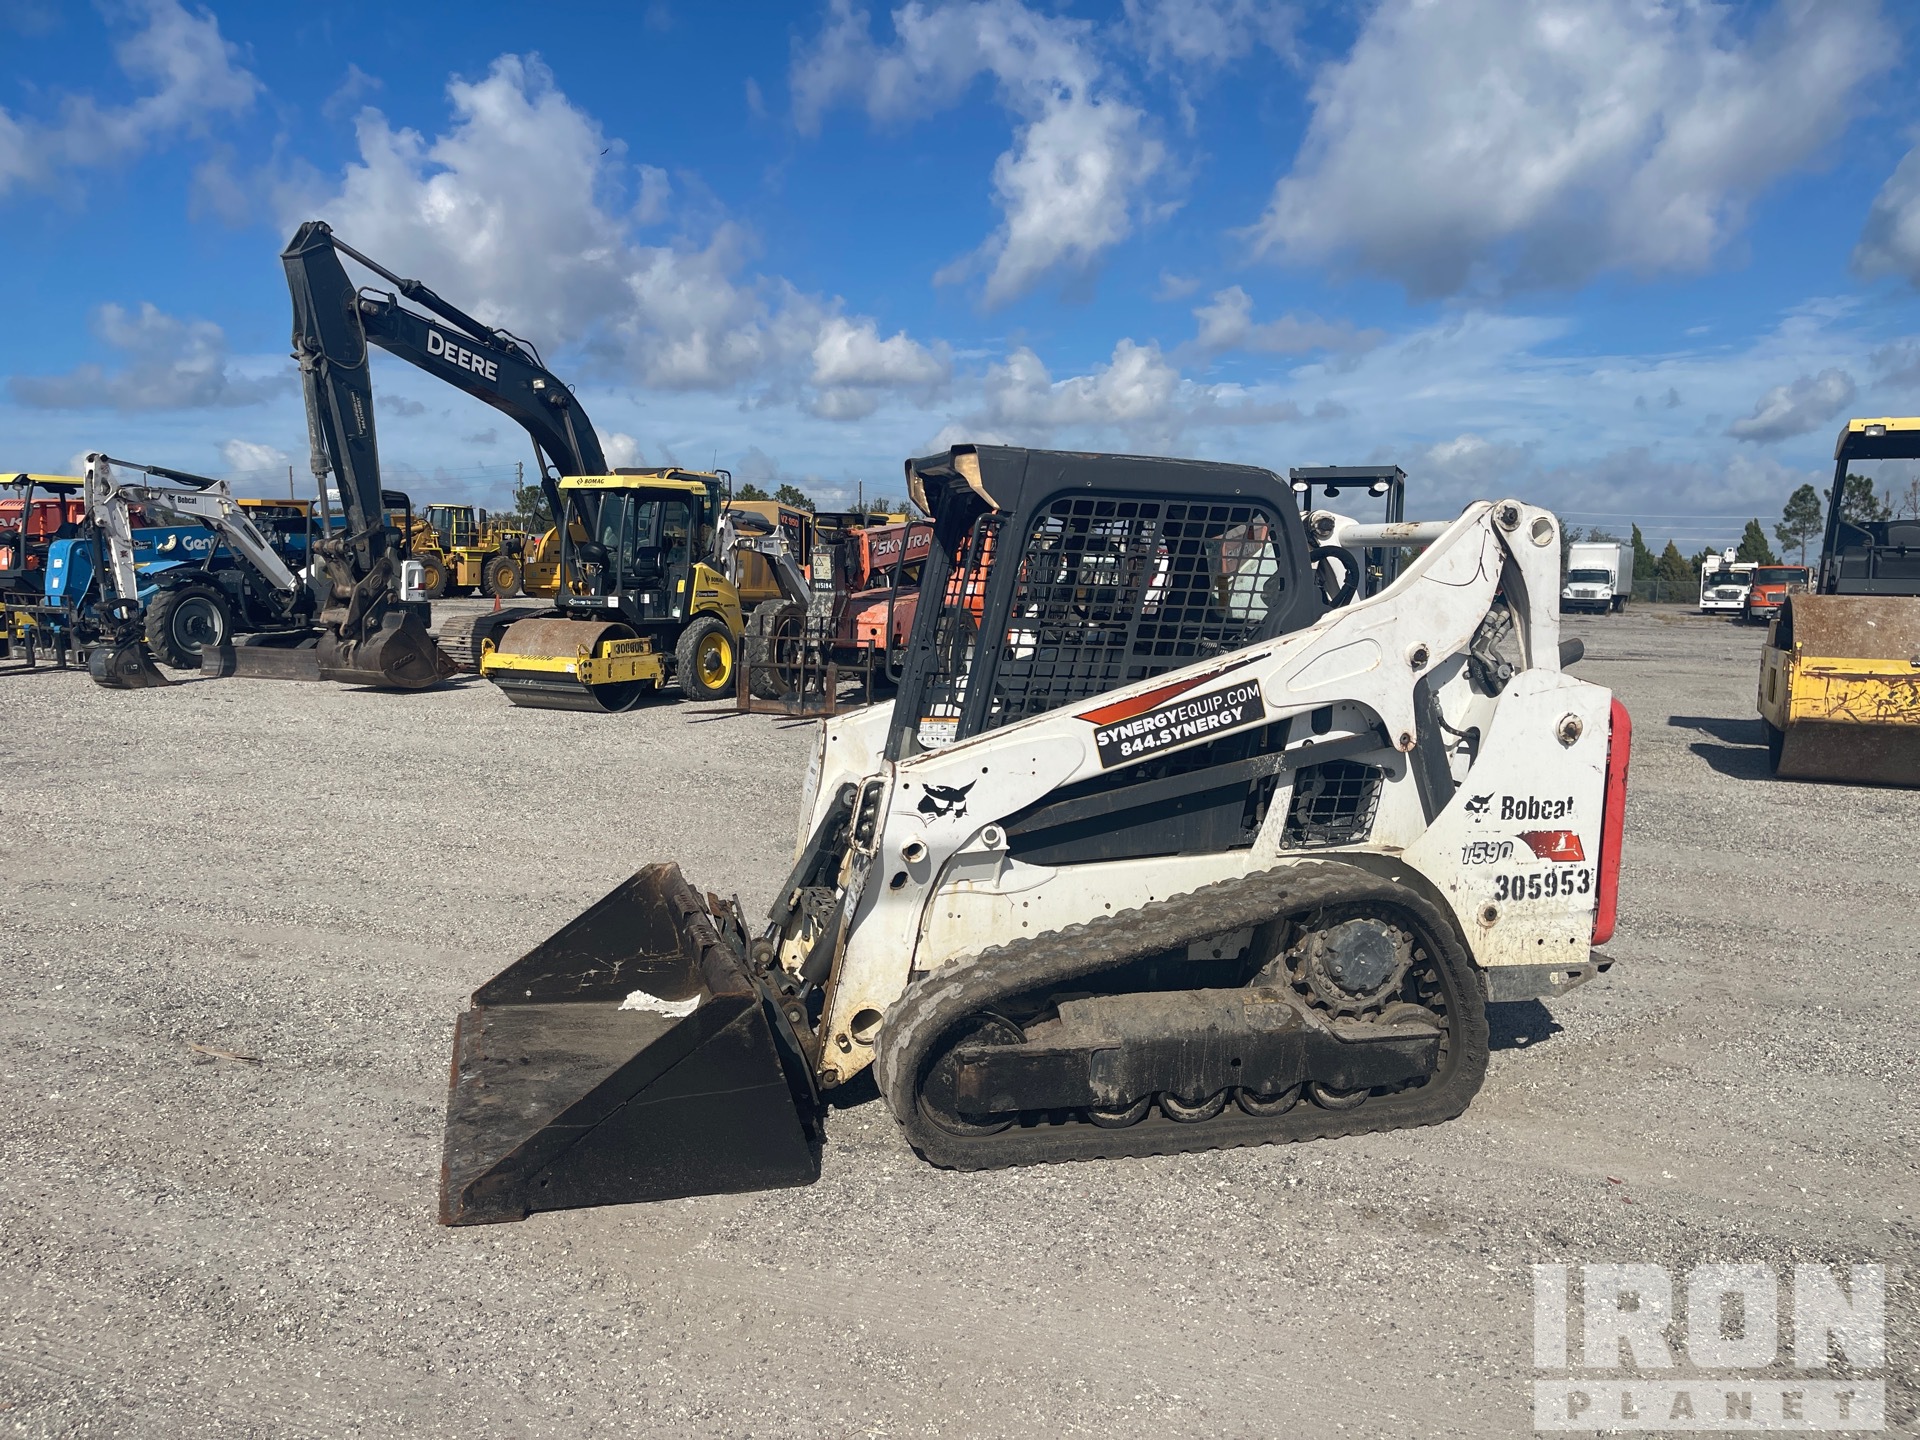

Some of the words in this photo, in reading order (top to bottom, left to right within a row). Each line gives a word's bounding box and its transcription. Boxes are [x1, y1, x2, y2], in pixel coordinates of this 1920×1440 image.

[427, 329, 498, 382] DEERE
[177, 495, 197, 505] Bobcat
[1097, 684, 1260, 747] SYNERGYEQUIP.COM
[1120, 706, 1243, 757] 844.SYNERGY
[1501, 795, 1574, 821] Bobcat
[1461, 840, 1514, 865] T590
[1494, 868, 1590, 901] 305953
